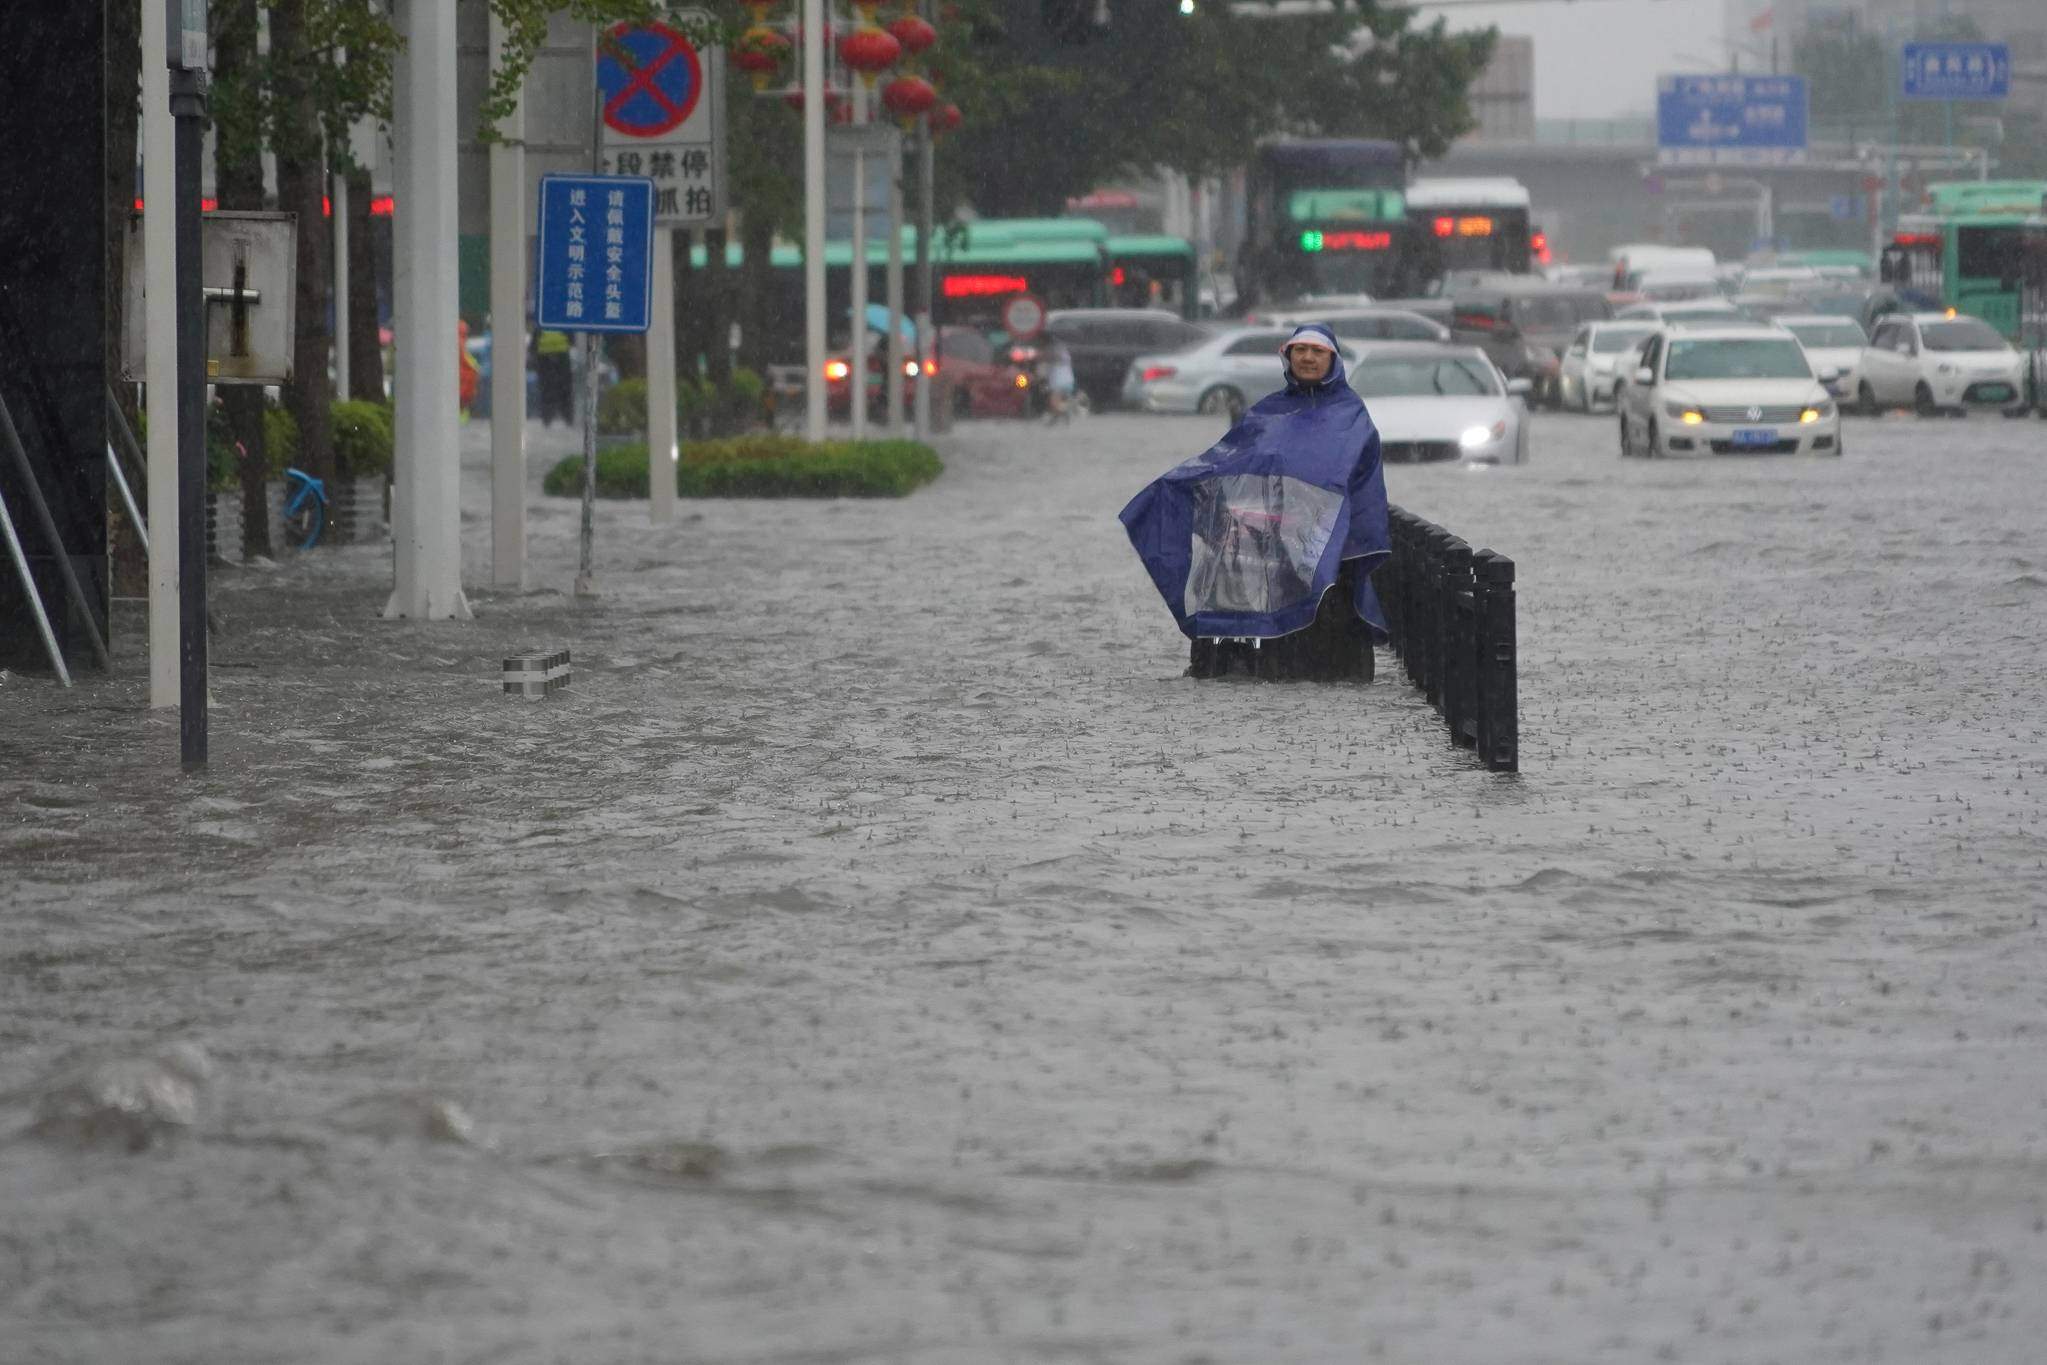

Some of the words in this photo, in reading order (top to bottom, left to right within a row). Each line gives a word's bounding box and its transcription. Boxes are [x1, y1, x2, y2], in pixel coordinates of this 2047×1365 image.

[602, 150, 709, 178] 段禁停
[566, 189, 586, 319] 进入文明示范路
[605, 189, 624, 319] 请佩戴安全头盔
